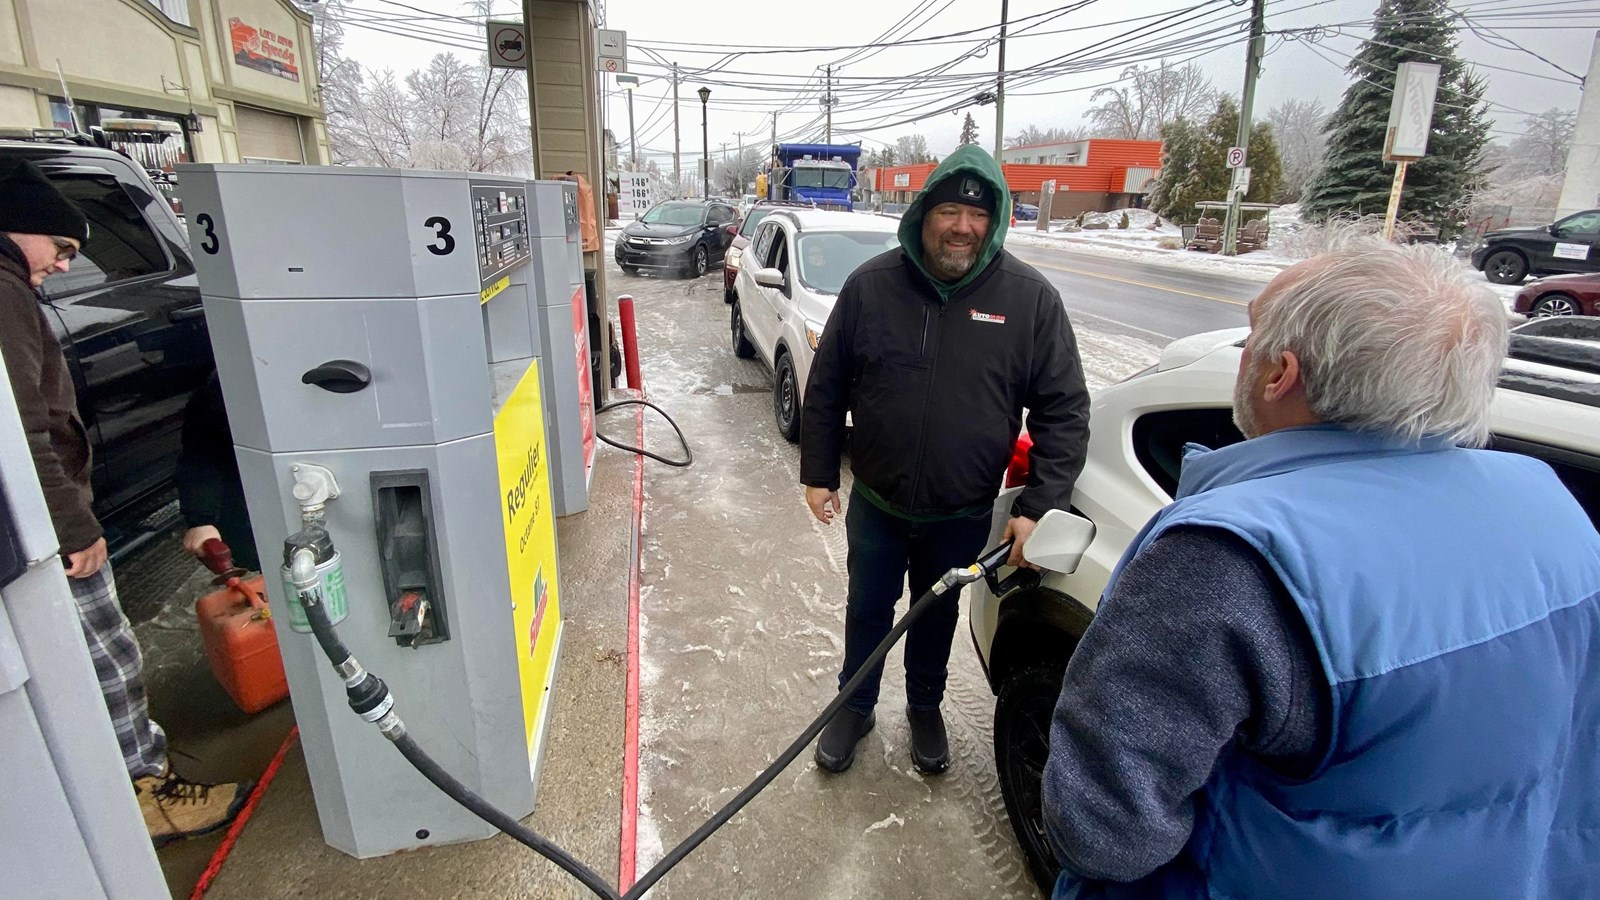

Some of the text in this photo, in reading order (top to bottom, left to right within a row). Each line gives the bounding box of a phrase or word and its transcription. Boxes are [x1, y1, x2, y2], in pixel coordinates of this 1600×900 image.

[261, 40, 295, 65] Speedy
[1233, 152, 1241, 162] P
[196, 212, 220, 255] 3
[423, 216, 456, 256] 3
[507, 440, 540, 525] Regulier
[519, 512, 535, 554] Octane
